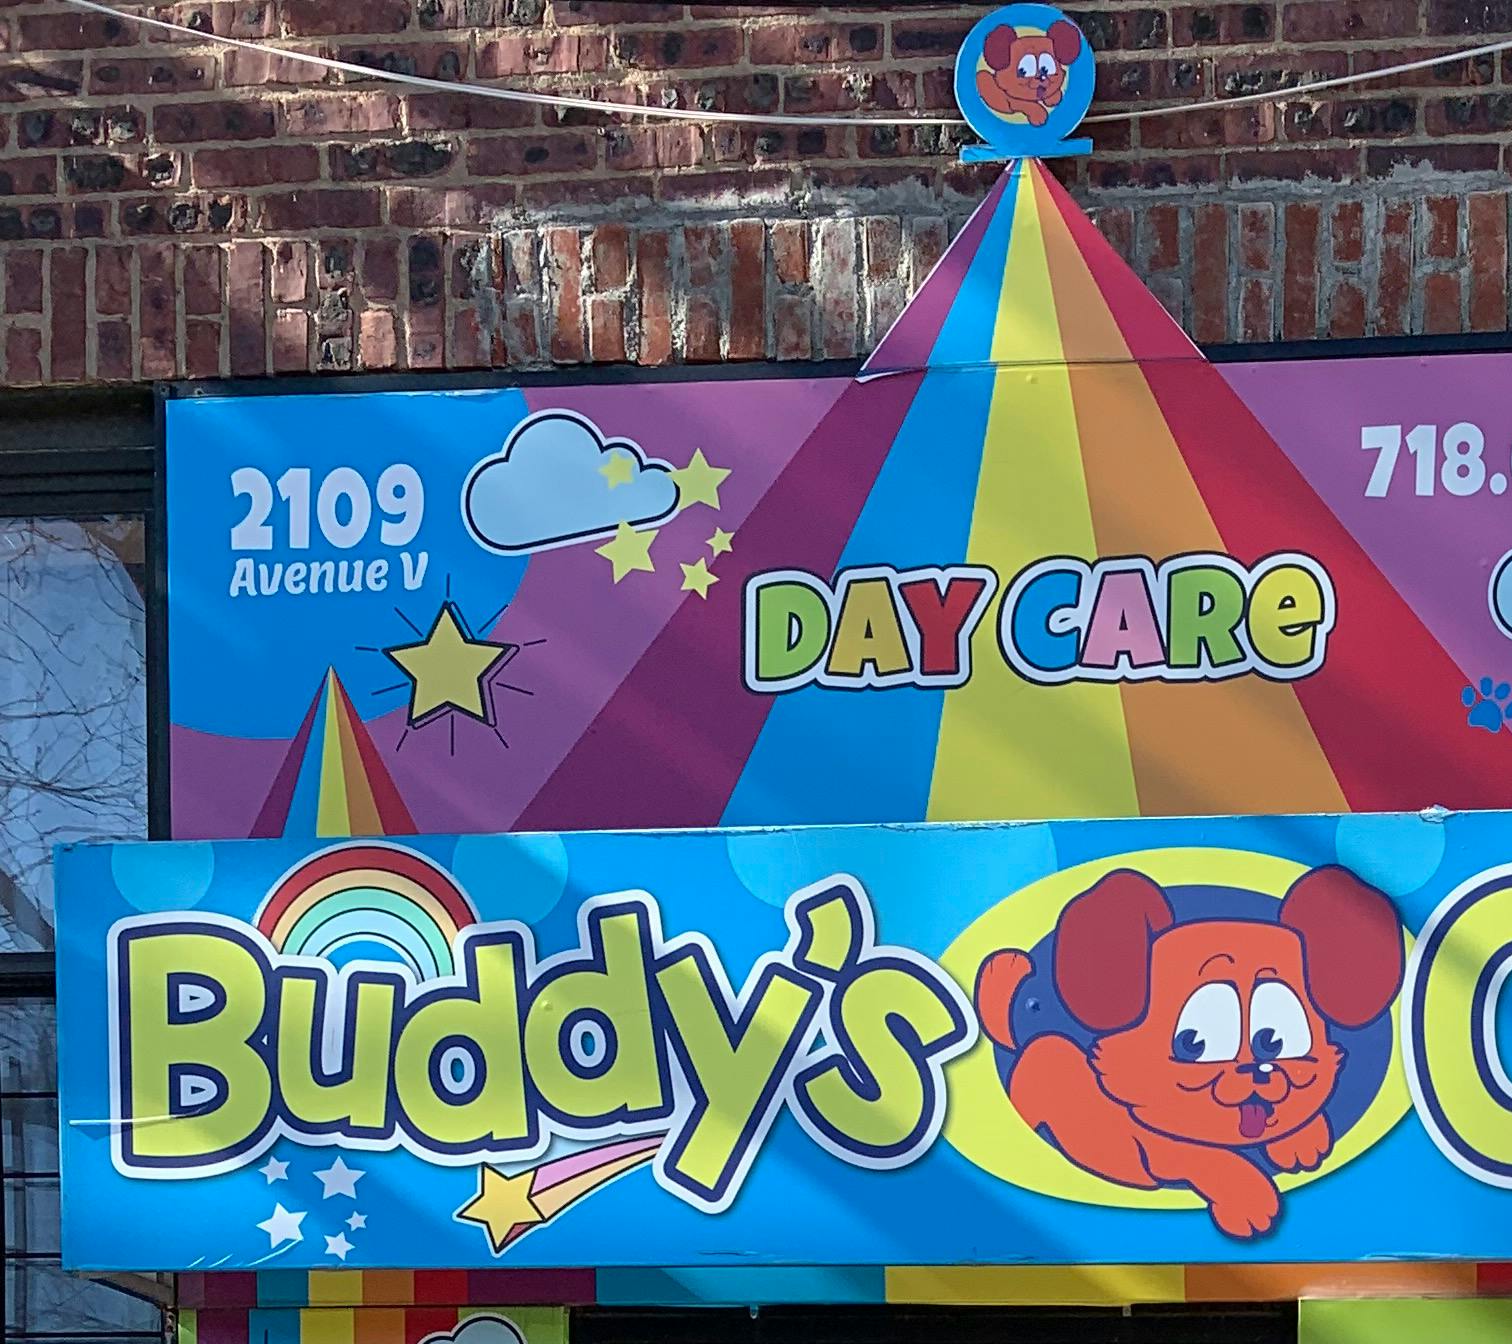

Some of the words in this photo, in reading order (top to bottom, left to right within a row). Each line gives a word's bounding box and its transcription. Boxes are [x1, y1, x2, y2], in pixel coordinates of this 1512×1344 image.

[229, 464, 425, 551] 2109
[229, 553, 388, 598] Avenue
[399, 552, 430, 592] V
[746, 566, 997, 693] DAY
[114, 880, 972, 1206] Buddy's
